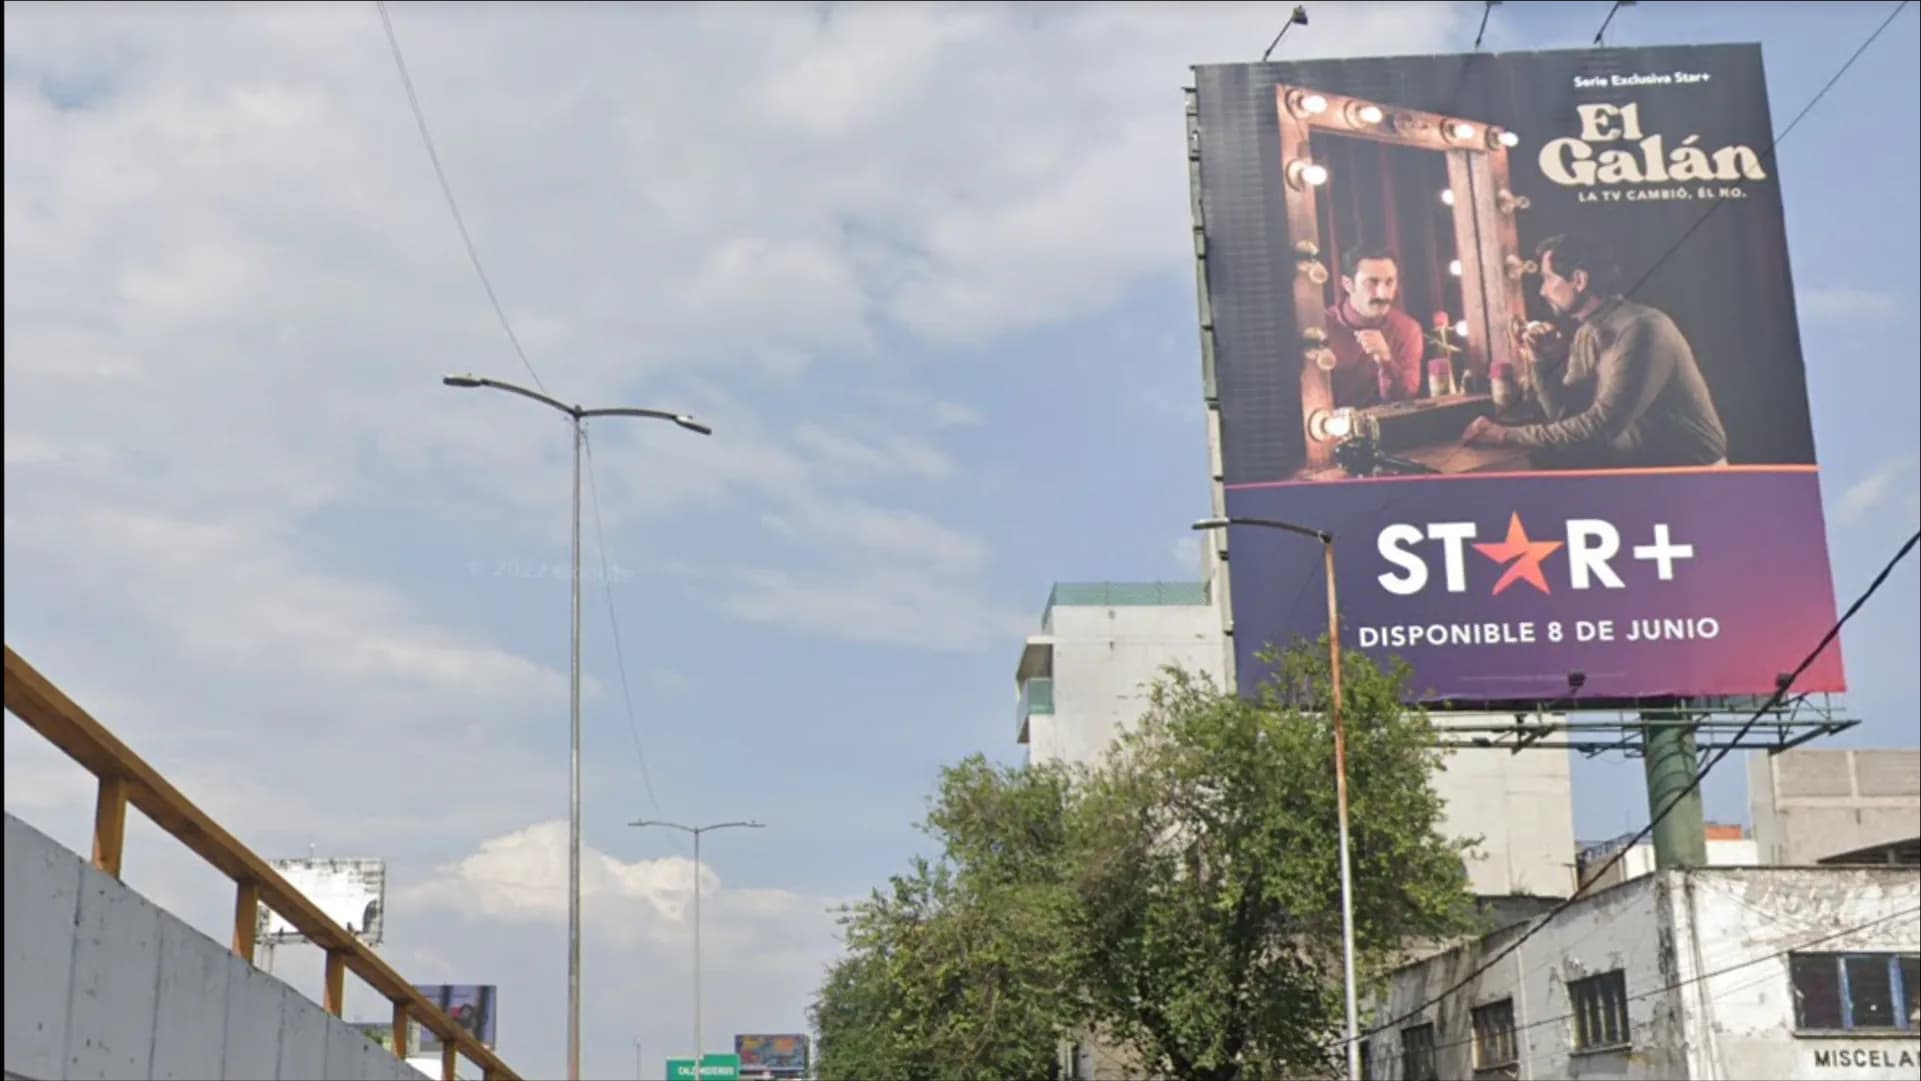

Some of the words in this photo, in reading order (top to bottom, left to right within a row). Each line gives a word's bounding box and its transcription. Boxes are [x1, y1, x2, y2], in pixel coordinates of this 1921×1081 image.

[1573, 76, 1608, 88] Serie
[1611, 73, 1672, 87] Exclusiva
[1674, 71, 1711, 84] Star+
[1576, 102, 1644, 142] El
[1538, 134, 1767, 186] Galán
[1578, 191, 1598, 203] LA
[1601, 190, 1622, 202] TV
[1625, 186, 1693, 201] CAMBIÓ,
[1697, 186, 1715, 199] ÉL
[1359, 621, 1536, 649] DISPONIBLE
[1547, 621, 1565, 643] 8
[1576, 619, 1615, 643] DE
[1626, 616, 1720, 641] JUNIO
[1814, 1049, 1920, 1068] MISCELA
